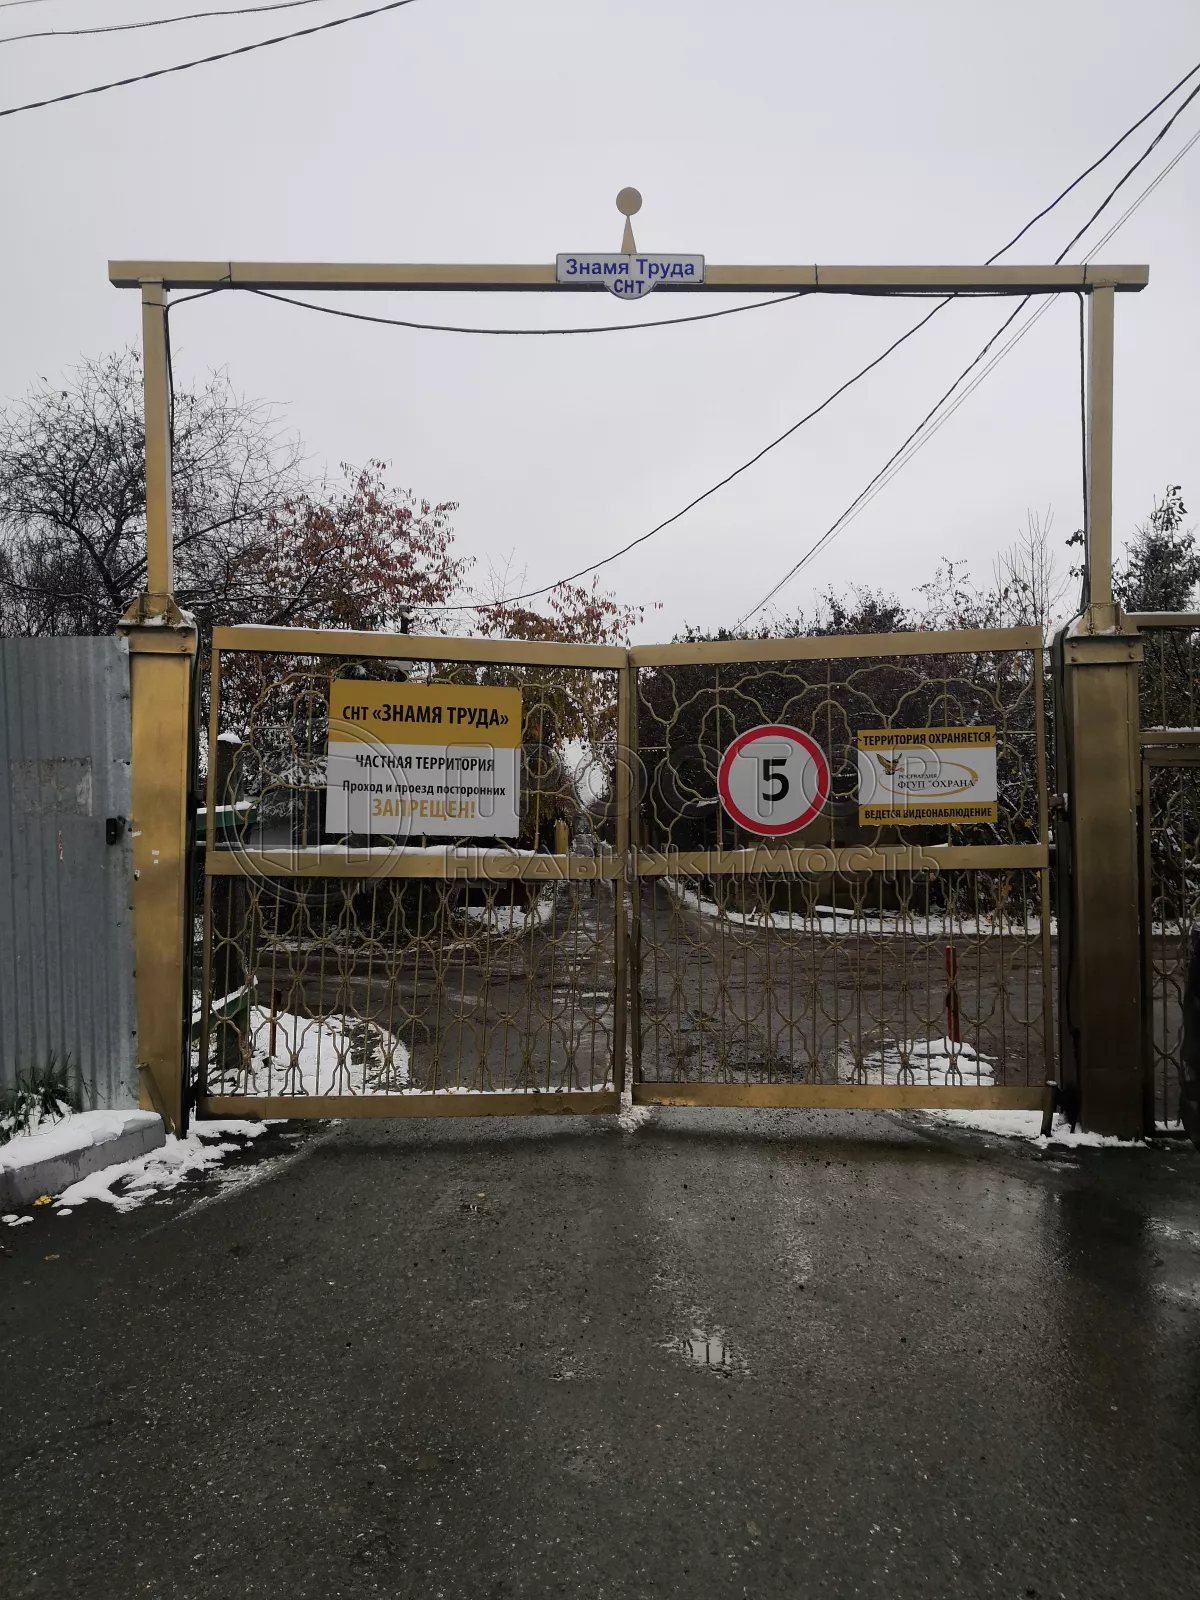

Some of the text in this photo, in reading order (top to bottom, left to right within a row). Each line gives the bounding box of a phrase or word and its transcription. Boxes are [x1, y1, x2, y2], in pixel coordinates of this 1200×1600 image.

[566, 258, 695, 279] Знамя Труда
[613, 279, 645, 294] СНТ
[342, 704, 509, 729] СНТ «ЗНАМЯ ТРУДА»
[863, 731, 991, 746] ТЕРРИТОРИЯ ОХРАНЯЕТСЯ
[355, 754, 495, 772] ЧАСТНАЯ ТЕРРИТОРИЯ
[342, 780, 506, 797] Проход и проезд посторонних
[762, 758, 790, 802] 5
[897, 780, 925, 789] ФГУП
[372, 798, 476, 821] ЗАПРЕЩЕН!
[864, 807, 993, 820] ВЕДЕТСЯ ВИДЕОНАБЛЮДЕНИЕ
